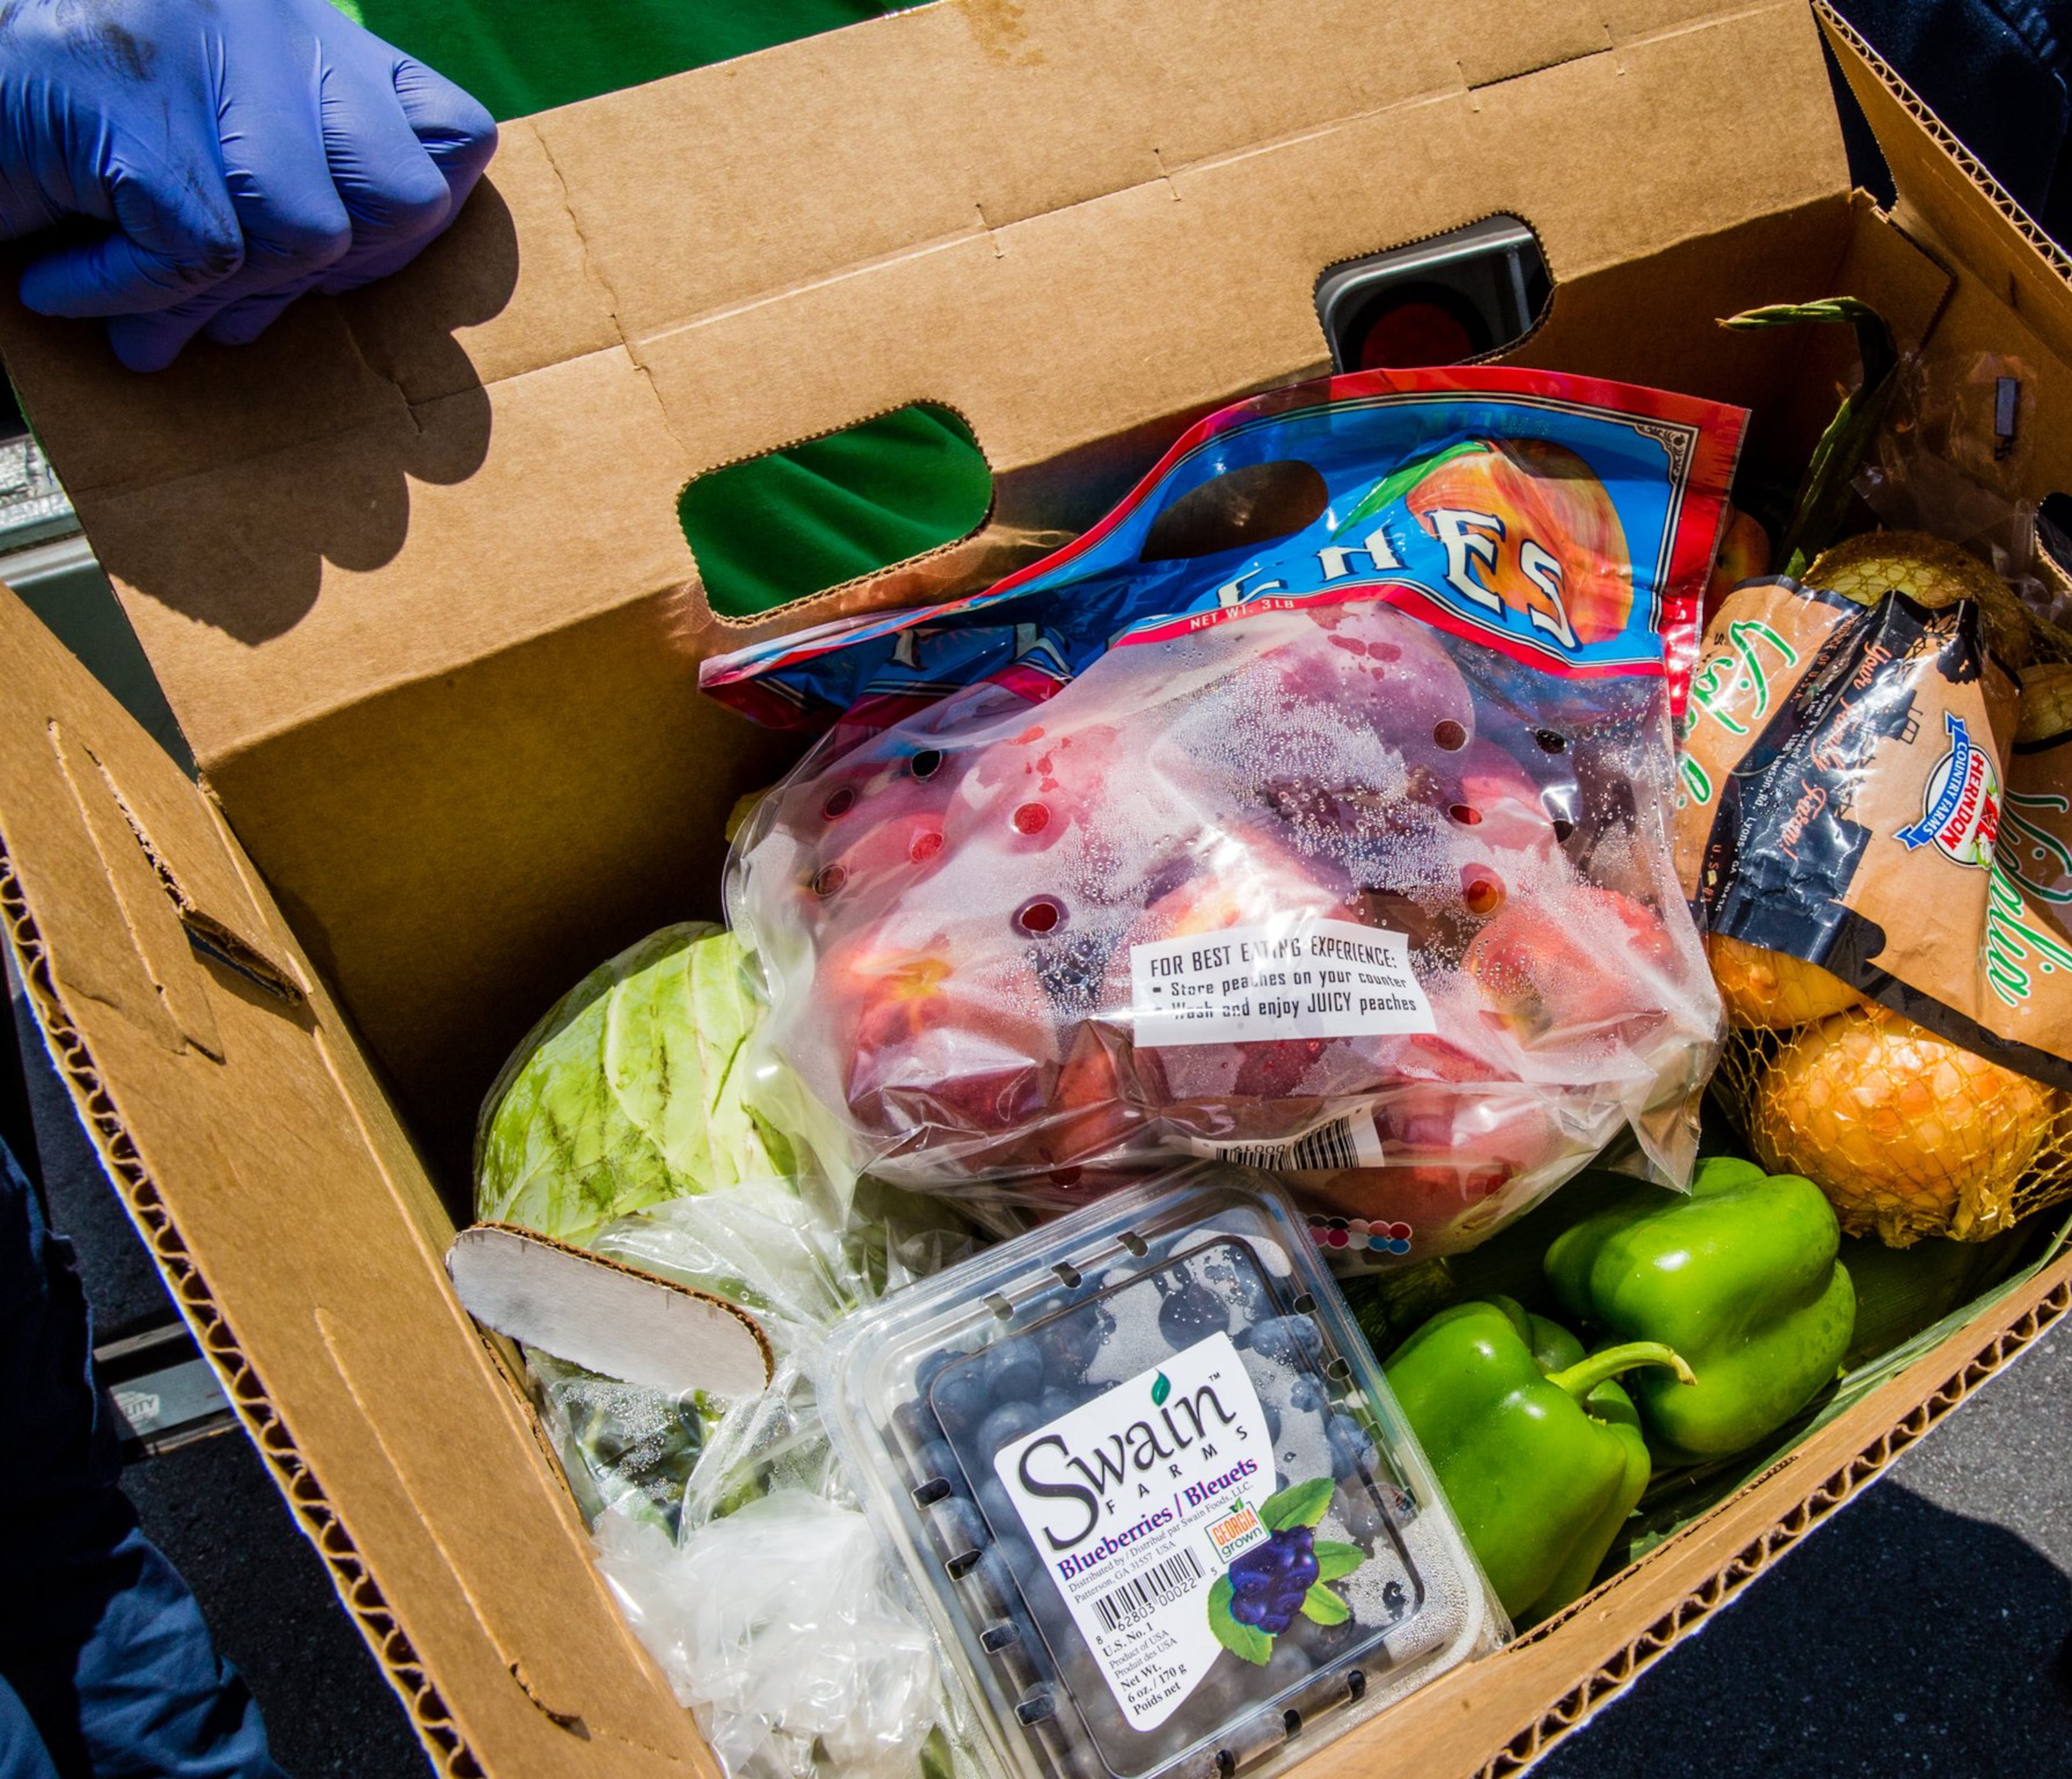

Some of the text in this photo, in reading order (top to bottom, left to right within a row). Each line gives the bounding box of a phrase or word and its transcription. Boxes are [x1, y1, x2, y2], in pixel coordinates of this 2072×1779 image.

[1190, 612, 1218, 630] NET
[1262, 599, 1271, 610] 3
[1275, 598, 1294, 609] LB
[1817, 653, 1830, 666] OF
[1853, 640, 1892, 690] Your
[1814, 693, 1832, 717] Grown
[1791, 730, 1813, 759] Packed
[1923, 741, 1968, 836] COUNTRY FARMS
[1939, 753, 1985, 851] HERNDON
[1781, 779, 1827, 862] Farm!
[1729, 859, 1741, 875] GA
[1151, 956, 1182, 977] FOR
[1192, 946, 1231, 971] BEST
[1311, 936, 1398, 969] EXPERIENCE:
[1171, 981, 1214, 997] Store
[1294, 971, 1311, 985] on
[1319, 970, 1351, 987] your
[1359, 972, 1407, 989] counter
[1223, 997, 1250, 1017] and
[1258, 997, 1299, 1019] enjoy
[1307, 992, 1351, 1013] JUICY
[1360, 994, 1416, 1015] peaches
[1017, 1381, 1237, 1552] Swain
[1106, 1426, 1248, 1515] FARMS
[1057, 1508, 1173, 1581] Blueberries
[1183, 1456, 1258, 1508] Bleuets
[1068, 1562, 1114, 1593] Distributed
[1113, 1557, 1124, 1566] by
[1129, 1530, 1167, 1557] Distribué
[1167, 1524, 1180, 1537] par
[1180, 1510, 1205, 1527] Swain
[1205, 1496, 1232, 1512] Foods,
[1231, 1482, 1253, 1497] LLC.
[1212, 1509, 1259, 1545] GEORGIA
[1221, 1528, 1263, 1558] grown
[1074, 1541, 1176, 1604] Patterson, GA 31557 USA
[1096, 1567, 1217, 1645] 8 62803 00022 5
[1103, 1640, 1127, 1657] U.S.
[1126, 1627, 1146, 1643] No.
[1109, 1631, 1169, 1669] Product of USA
[1114, 1638, 1177, 1679] Produit des USA
[1120, 1664, 1161, 1691] Net Wt.
[1128, 1694, 1135, 1702] 6
[1137, 1687, 1153, 1698] oz.
[1159, 1668, 1176, 1683] 170
[1178, 1664, 1187, 1675] g
[1133, 1682, 1181, 1715] Poids net
